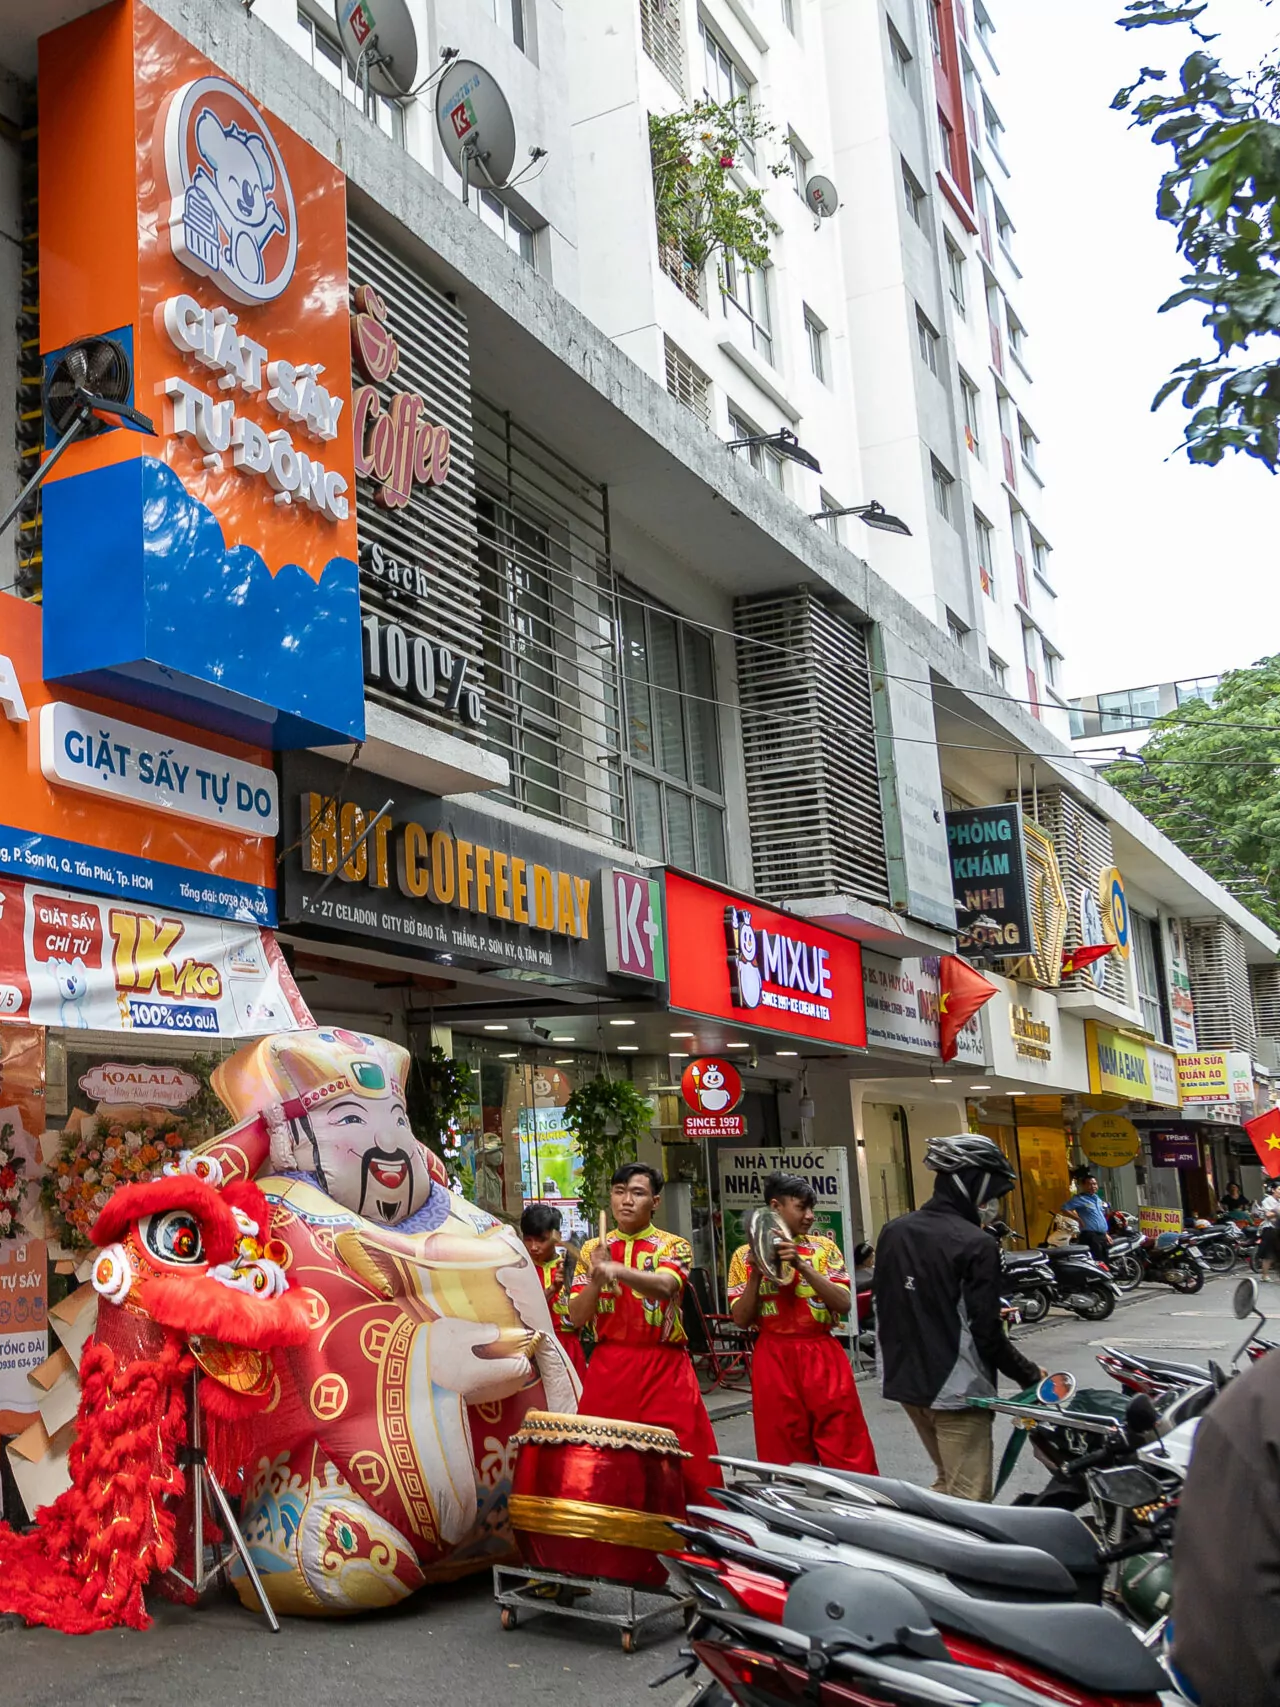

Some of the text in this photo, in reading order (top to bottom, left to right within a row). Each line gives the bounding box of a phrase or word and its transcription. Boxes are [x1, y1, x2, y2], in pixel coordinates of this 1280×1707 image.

[163, 294, 345, 442] GIẶT SẤY
[164, 376, 349, 522] TỰ ĐỘNG
[353, 384, 451, 509] Coffee
[362, 614, 482, 723] 100%
[64, 729, 271, 818] GIẶT SẤY TỰ DO
[302, 792, 392, 889] HOT
[948, 816, 1012, 846] PHÒNG
[13, 849, 22, 863] P.
[25, 850, 44, 868] Sơn
[61, 858, 73, 874] Q.
[131, 873, 154, 891] HCM
[954, 849, 1010, 879] KHÁM
[179, 883, 200, 902] Tổng
[201, 889, 218, 904] đài:
[218, 892, 238, 908] 0938
[964, 887, 1005, 911] NHI
[40, 907, 96, 933] GIẶT SẤY
[322, 900, 333, 917] 27
[336, 903, 377, 928] CELADON
[382, 913, 401, 932] CITY
[417, 922, 433, 939] BAO
[617, 876, 660, 968] K+
[45, 932, 92, 955] CHỈ TỪ
[760, 928, 833, 999] MIXUE
[131, 1002, 218, 1030] 100% CÓ QUÀ
[102, 1072, 183, 1085] KOALALA
[1098, 1043, 1118, 1077] NAM
[1124, 1052, 1147, 1085] BANK
[686, 1117, 740, 1127] SINCE 1997
[734, 1151, 824, 1169] NHÀ THUỐC
[0, 1269, 41, 1292] TỰ SẤY
[28, 1337, 45, 1352] ĐÀI
[18, 1358, 31, 1368] 634
